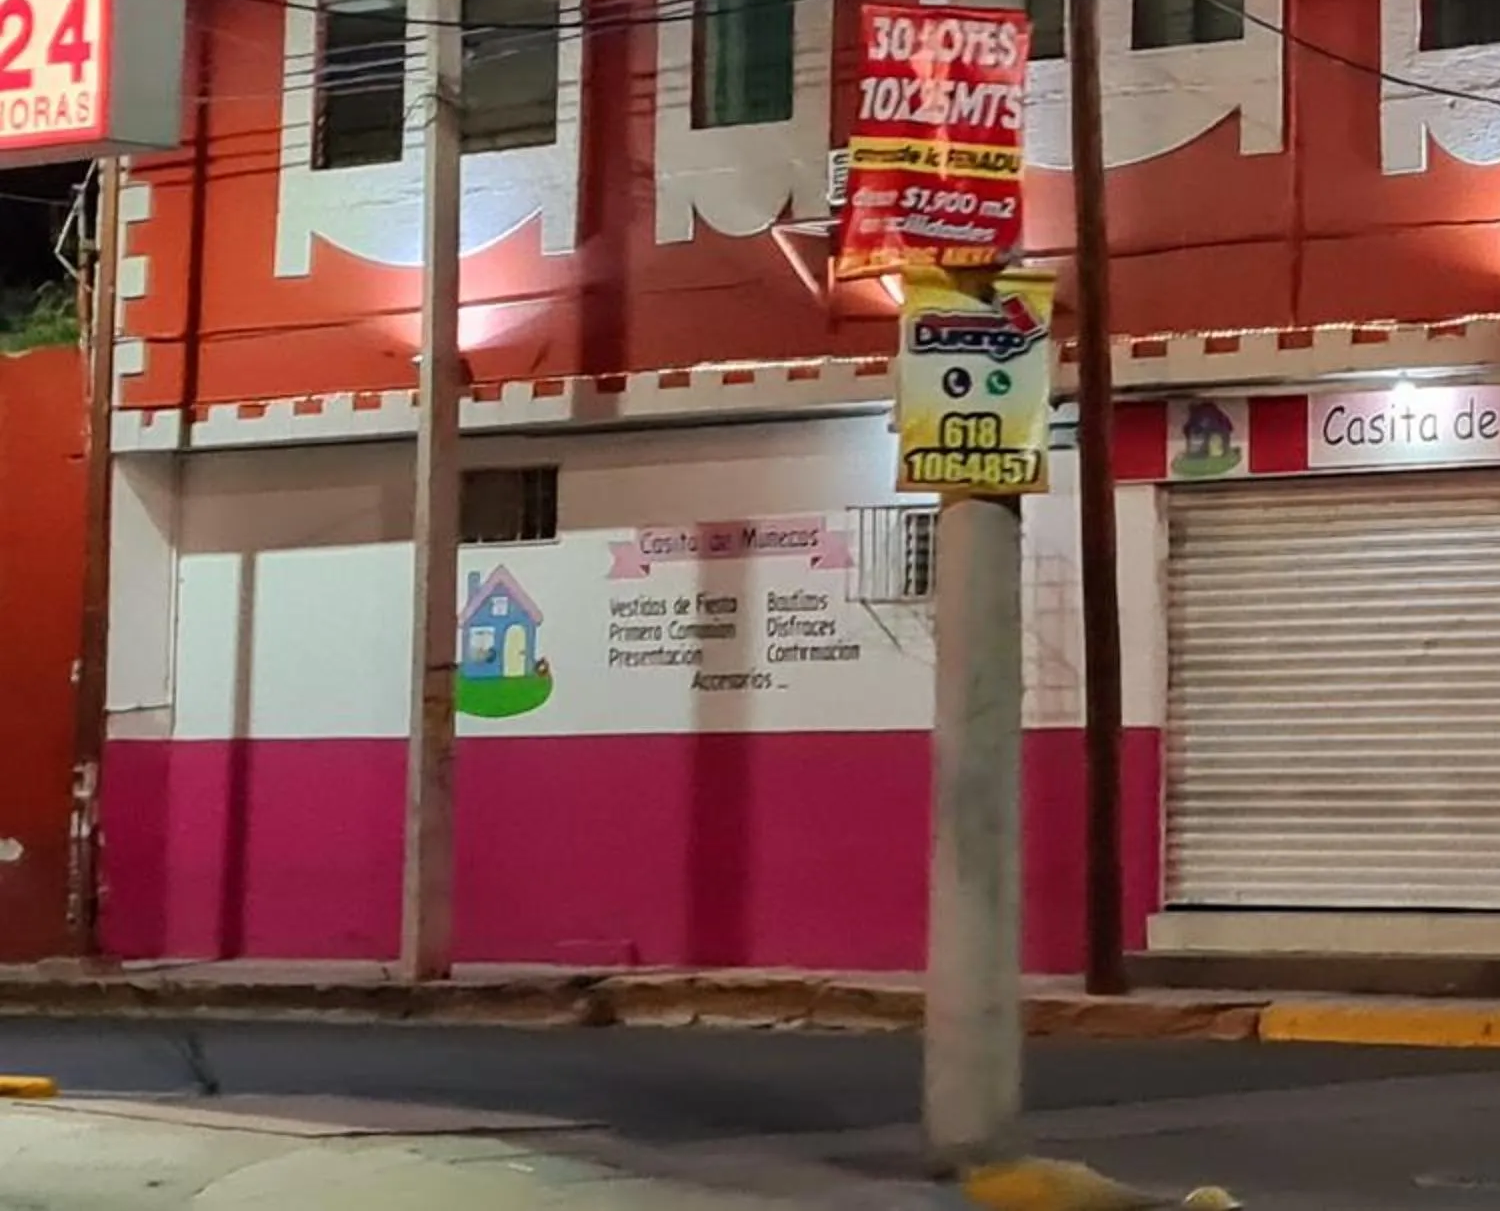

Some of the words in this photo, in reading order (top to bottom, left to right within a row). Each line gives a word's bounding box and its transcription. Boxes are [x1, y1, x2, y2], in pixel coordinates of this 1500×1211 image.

[868, 17, 915, 61] 30
[944, 415, 998, 448] 618
[1323, 403, 1439, 446] Casita
[1453, 397, 1500, 441] de
[673, 597, 691, 615] de
